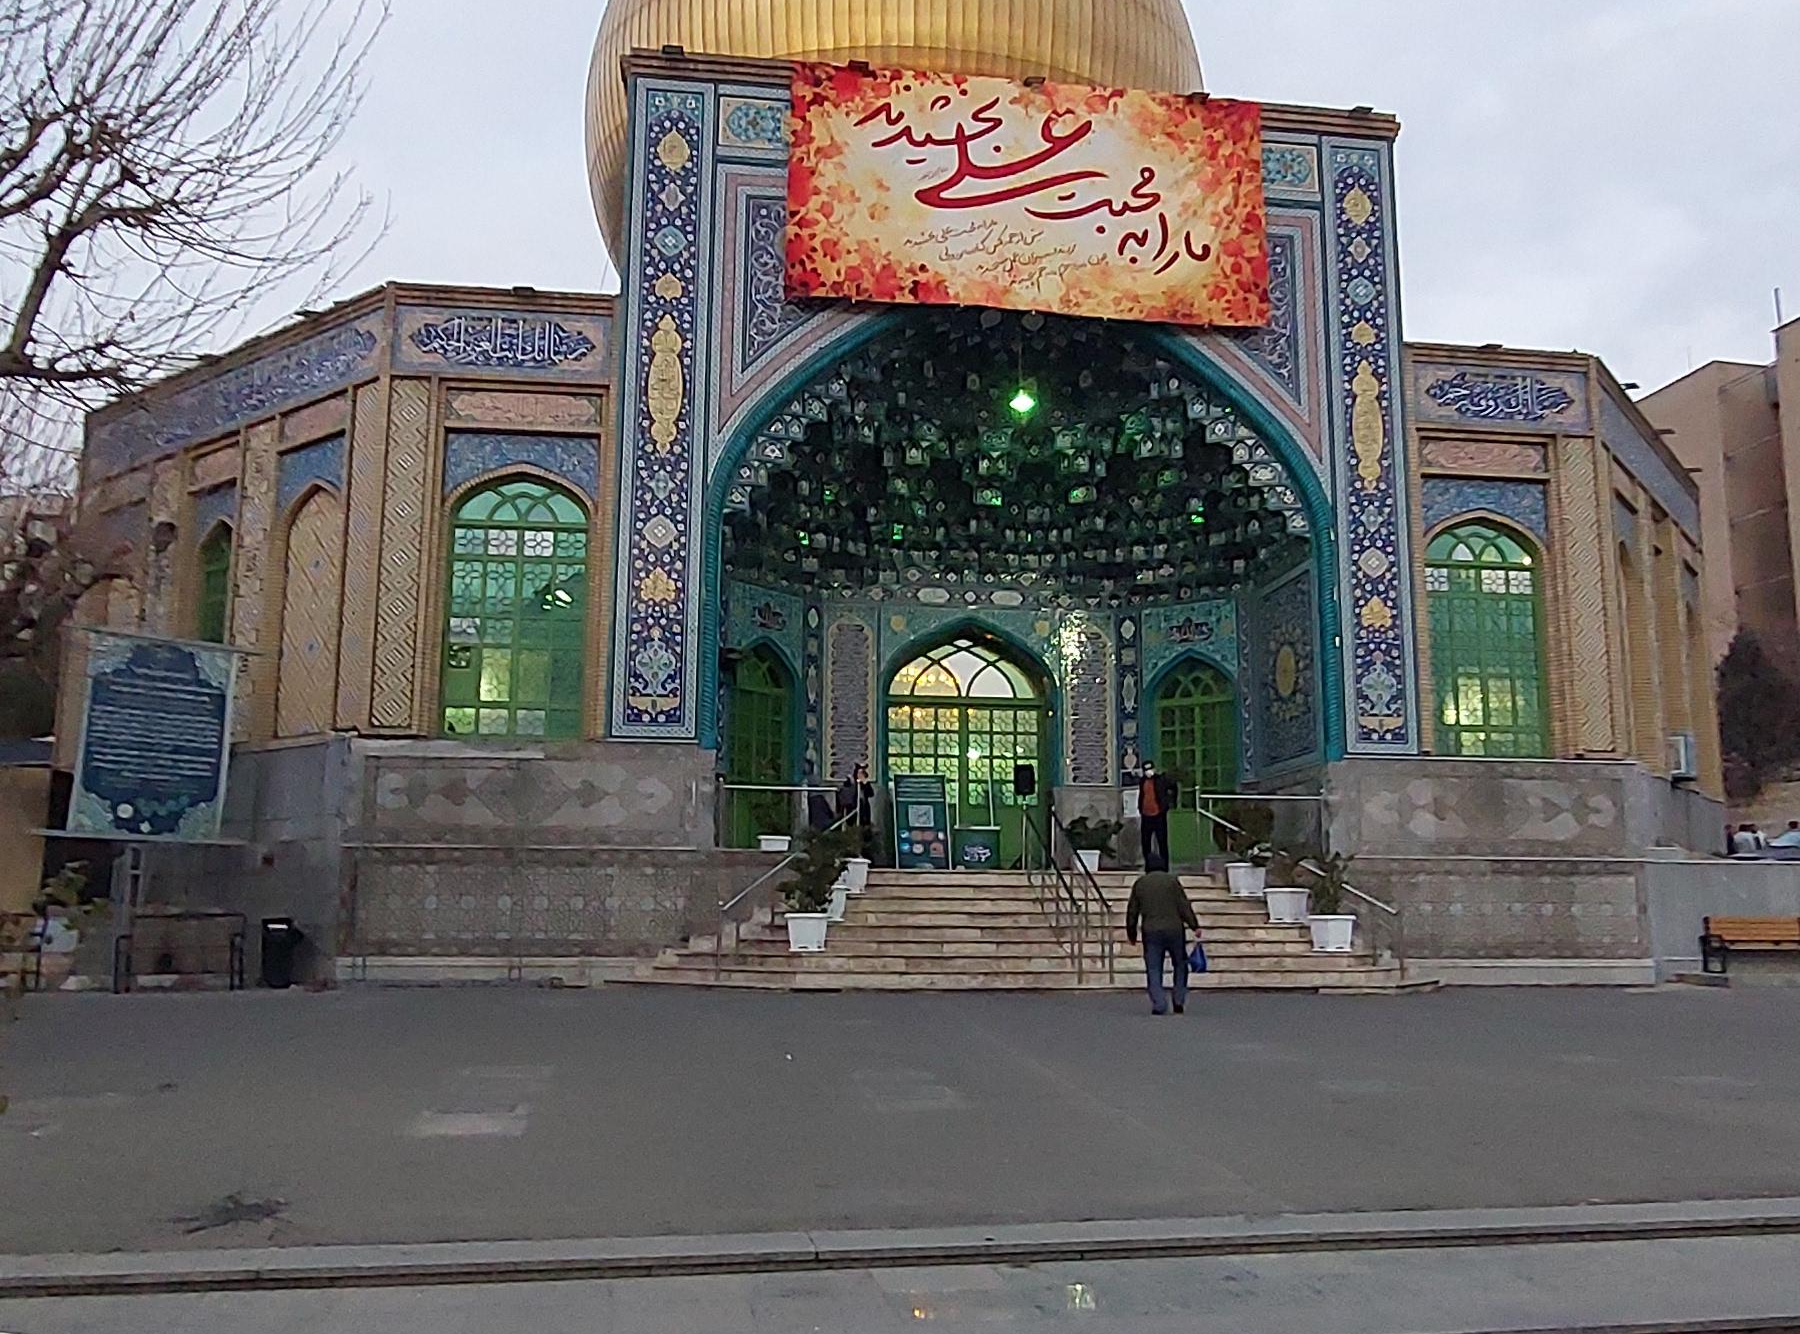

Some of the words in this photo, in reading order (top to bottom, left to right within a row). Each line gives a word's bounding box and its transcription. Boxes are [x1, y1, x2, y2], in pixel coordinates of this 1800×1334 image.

[853, 84, 1003, 165] بخشیدند
[914, 108, 1109, 209] علی
[1024, 167, 1161, 235] محبت
[1117, 229, 1149, 264] به
[1152, 212, 1180, 276] را
[1184, 230, 1211, 262] ما
